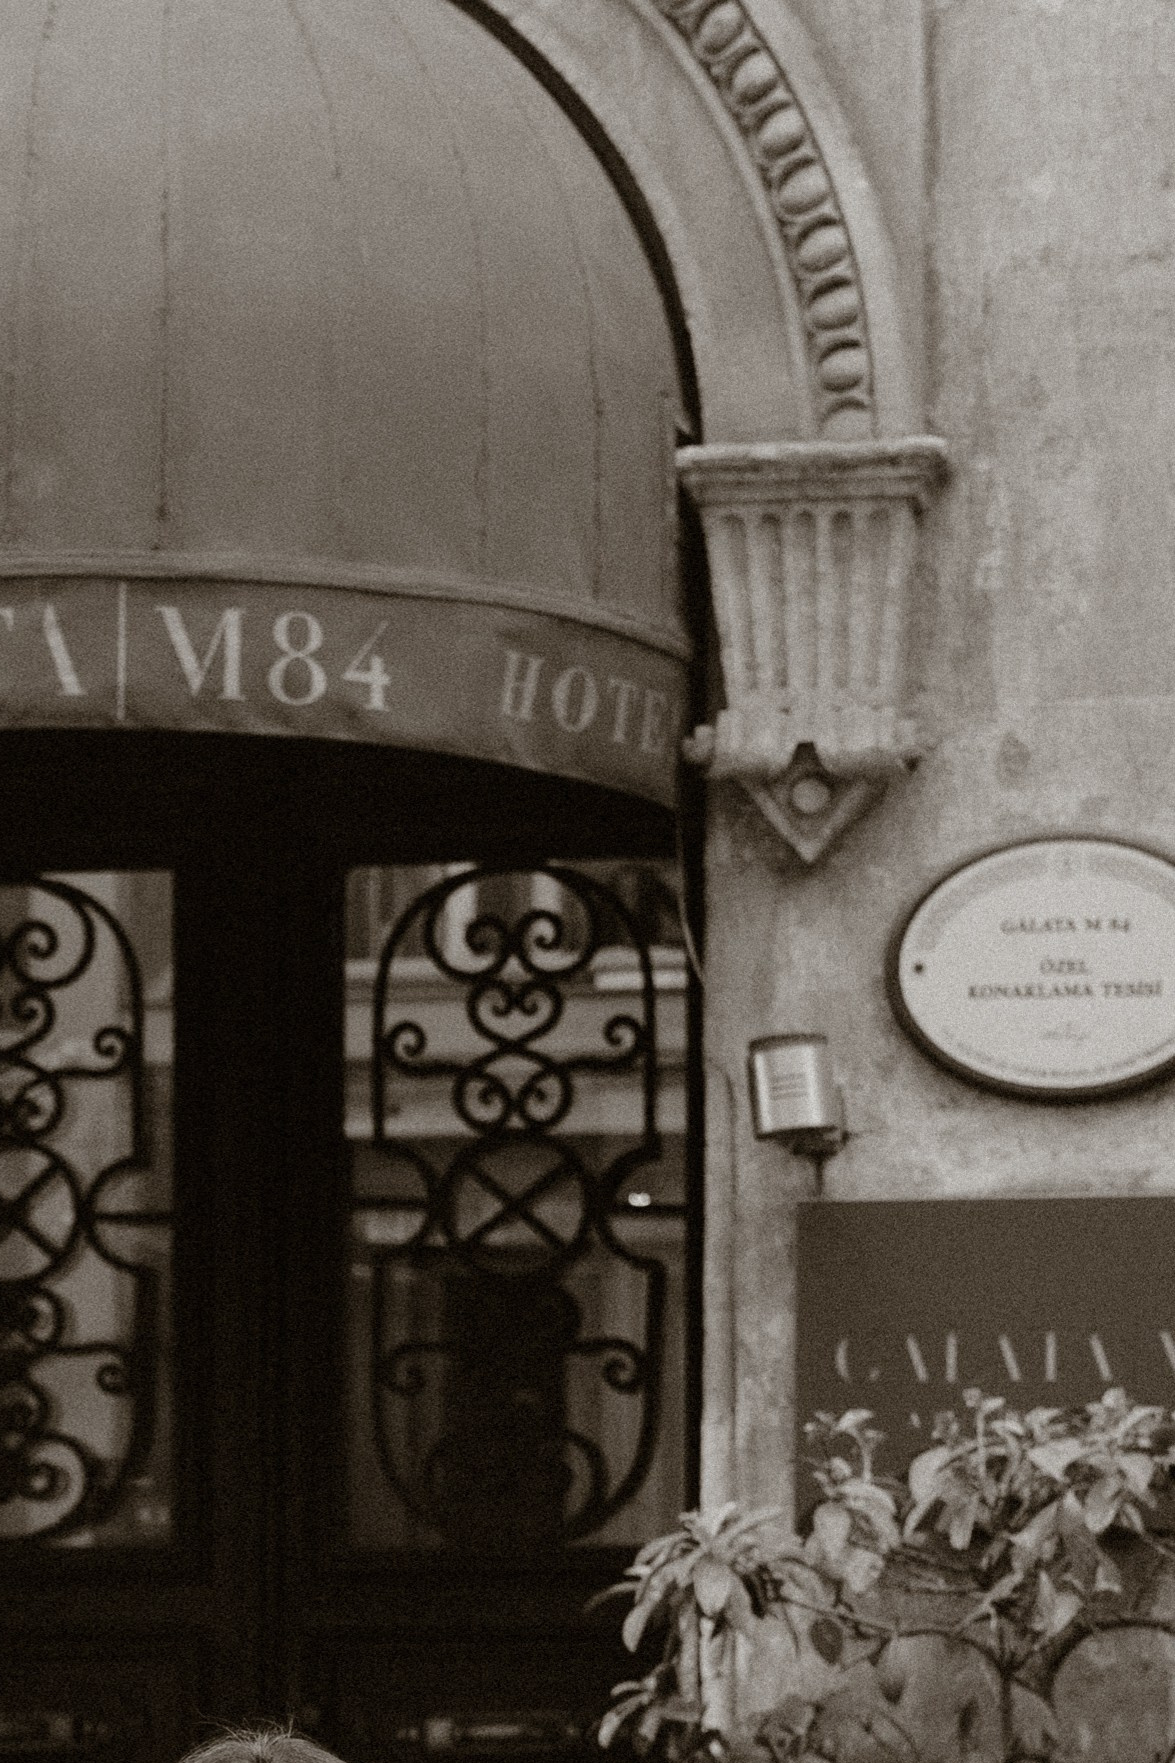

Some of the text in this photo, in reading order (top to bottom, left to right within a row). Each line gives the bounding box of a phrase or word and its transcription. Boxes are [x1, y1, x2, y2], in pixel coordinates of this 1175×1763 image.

[154, 604, 392, 712] M84
[999, 917, 1132, 935] GALATA M 84
[1039, 956, 1090, 976] ÖZEL
[967, 983, 1094, 999] KONAKLAMA
